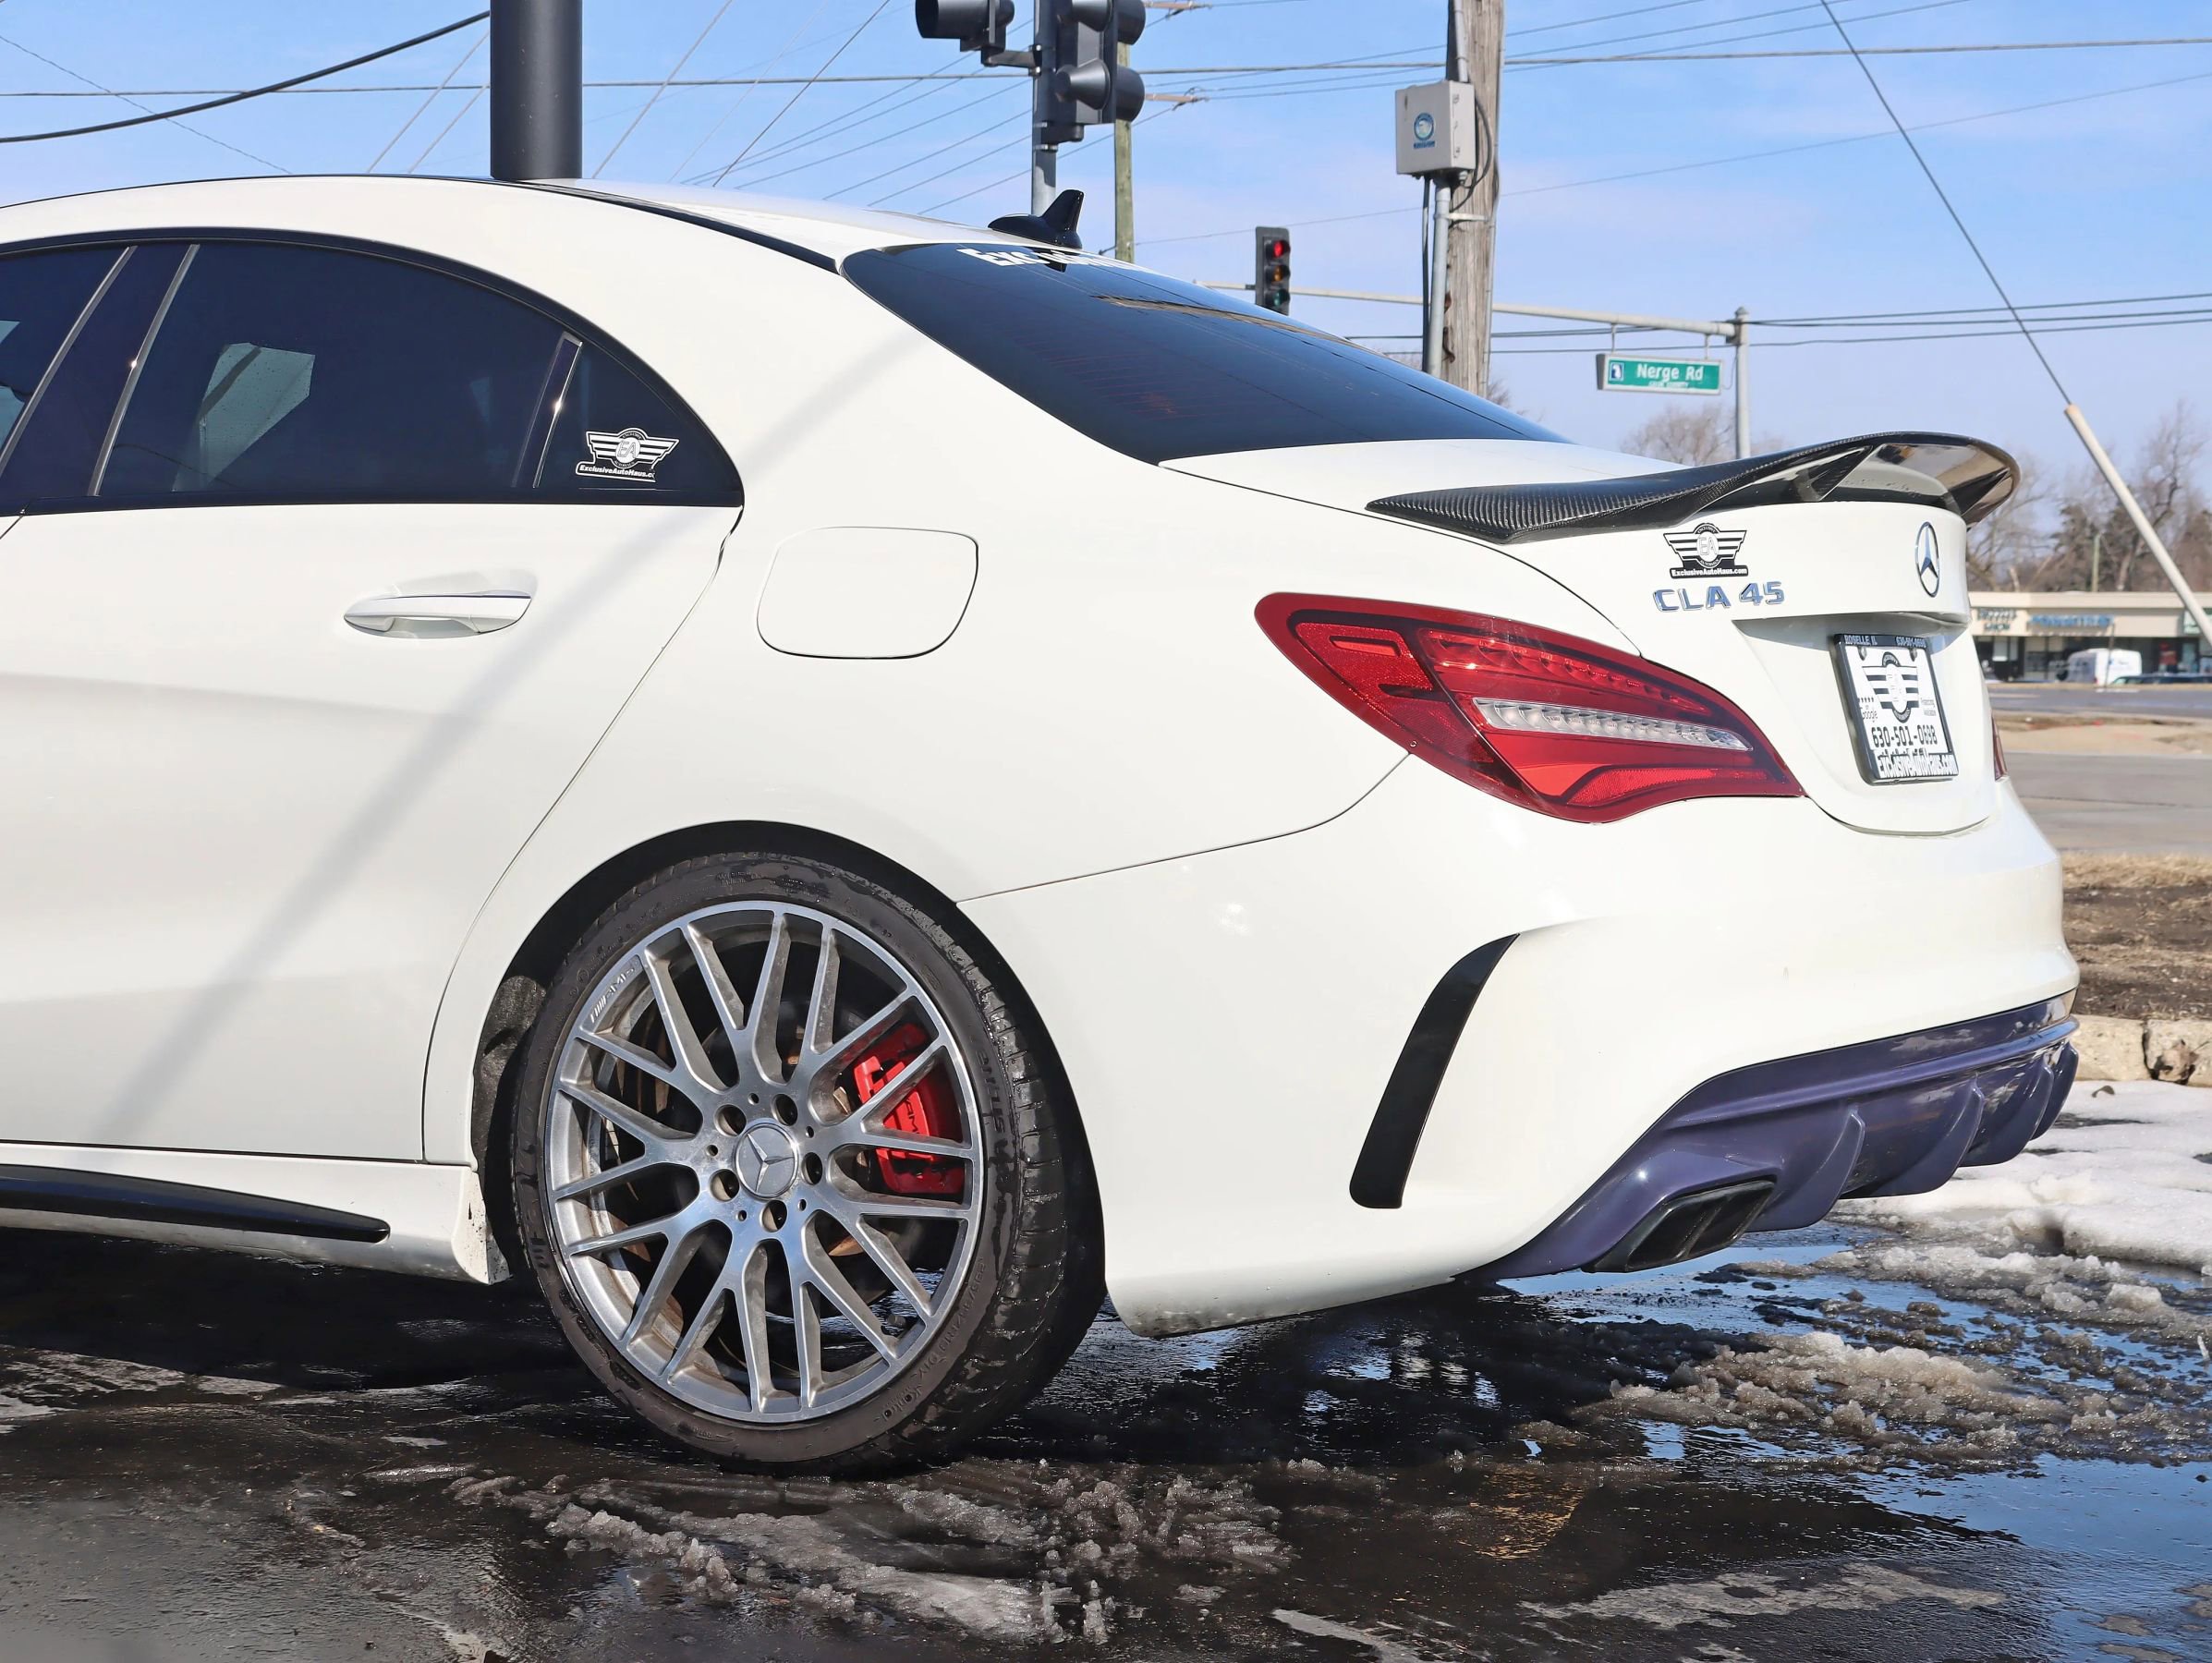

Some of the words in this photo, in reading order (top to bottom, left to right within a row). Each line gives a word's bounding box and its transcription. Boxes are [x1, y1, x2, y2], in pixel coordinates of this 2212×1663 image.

[1636, 363, 1680, 382] Nerge
[1685, 366, 1704, 381] Rd
[579, 465, 655, 479] ExclusiveAutoHaus.c
[1671, 567, 1747, 577] ExclusiveAutoHaus.com
[1653, 585, 1732, 612] CLA
[1739, 581, 1785, 606] 45
